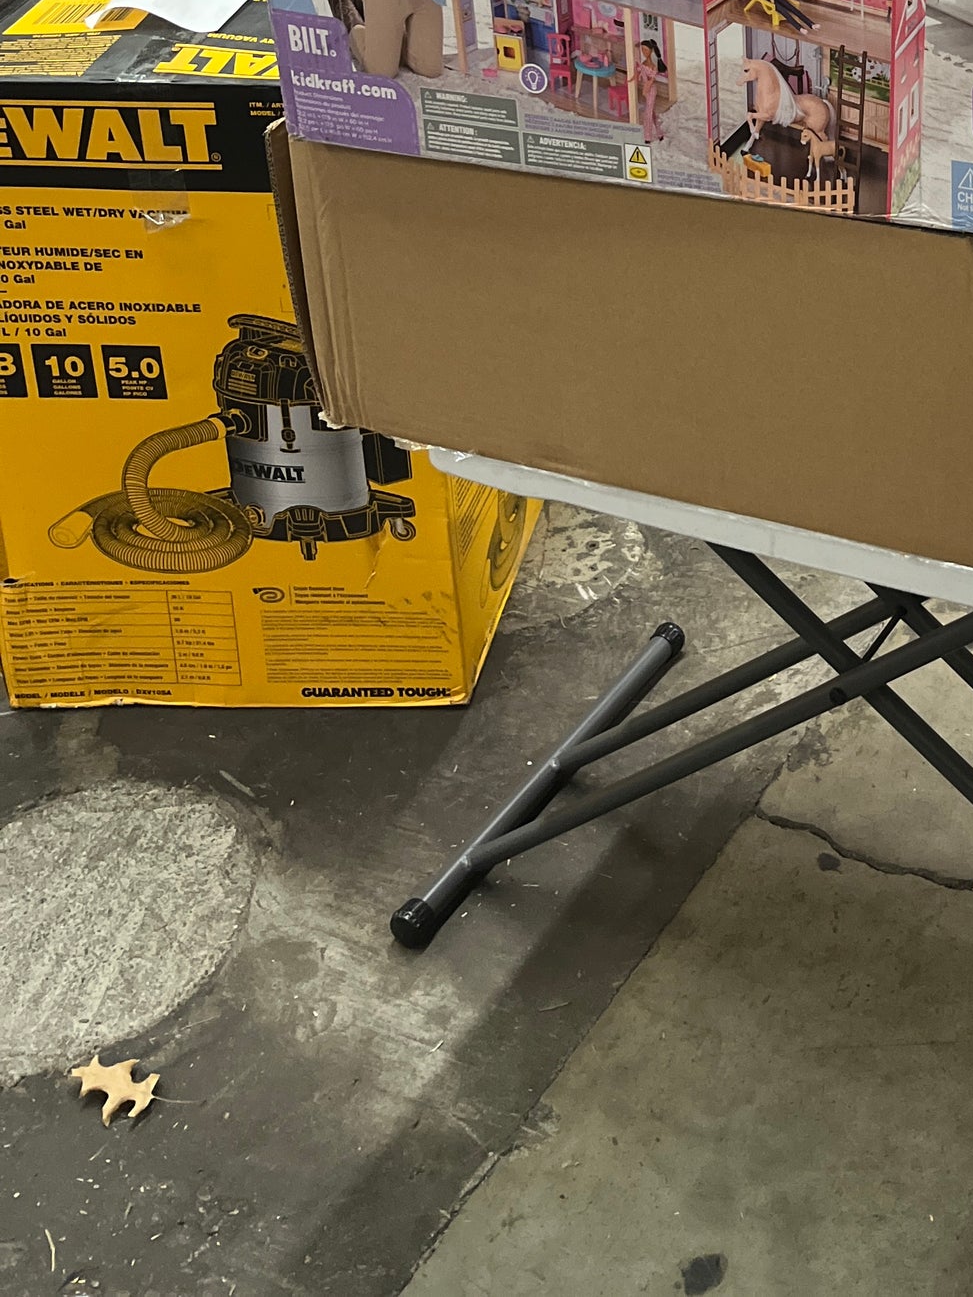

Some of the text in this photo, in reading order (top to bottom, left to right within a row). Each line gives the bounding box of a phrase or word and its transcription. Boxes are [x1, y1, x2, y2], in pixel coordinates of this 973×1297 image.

[290, 69, 397, 100] kidkraft.com
[439, 123, 475, 136] ATTENTION
[539, 136, 587, 150] ADVERTENCIA:
[15, 206, 125, 219] STEEL WET/DRY
[957, 203, 969, 212] Not
[4, 219, 26, 230] Gal
[34, 247, 144, 259] HUMIDE/SEC EN
[84, 262, 103, 272] DE
[13, 274, 35, 284] Gal
[49, 300, 201, 313] DE ACERO INOXIDABLE
[64, 313, 136, 325] Y SÓLIDOS
[2, 327, 67, 337] L 10 Gal
[44, 355, 85, 377] 10
[108, 356, 160, 379] 5.0
[301, 687, 394, 698] GUARANTEED
